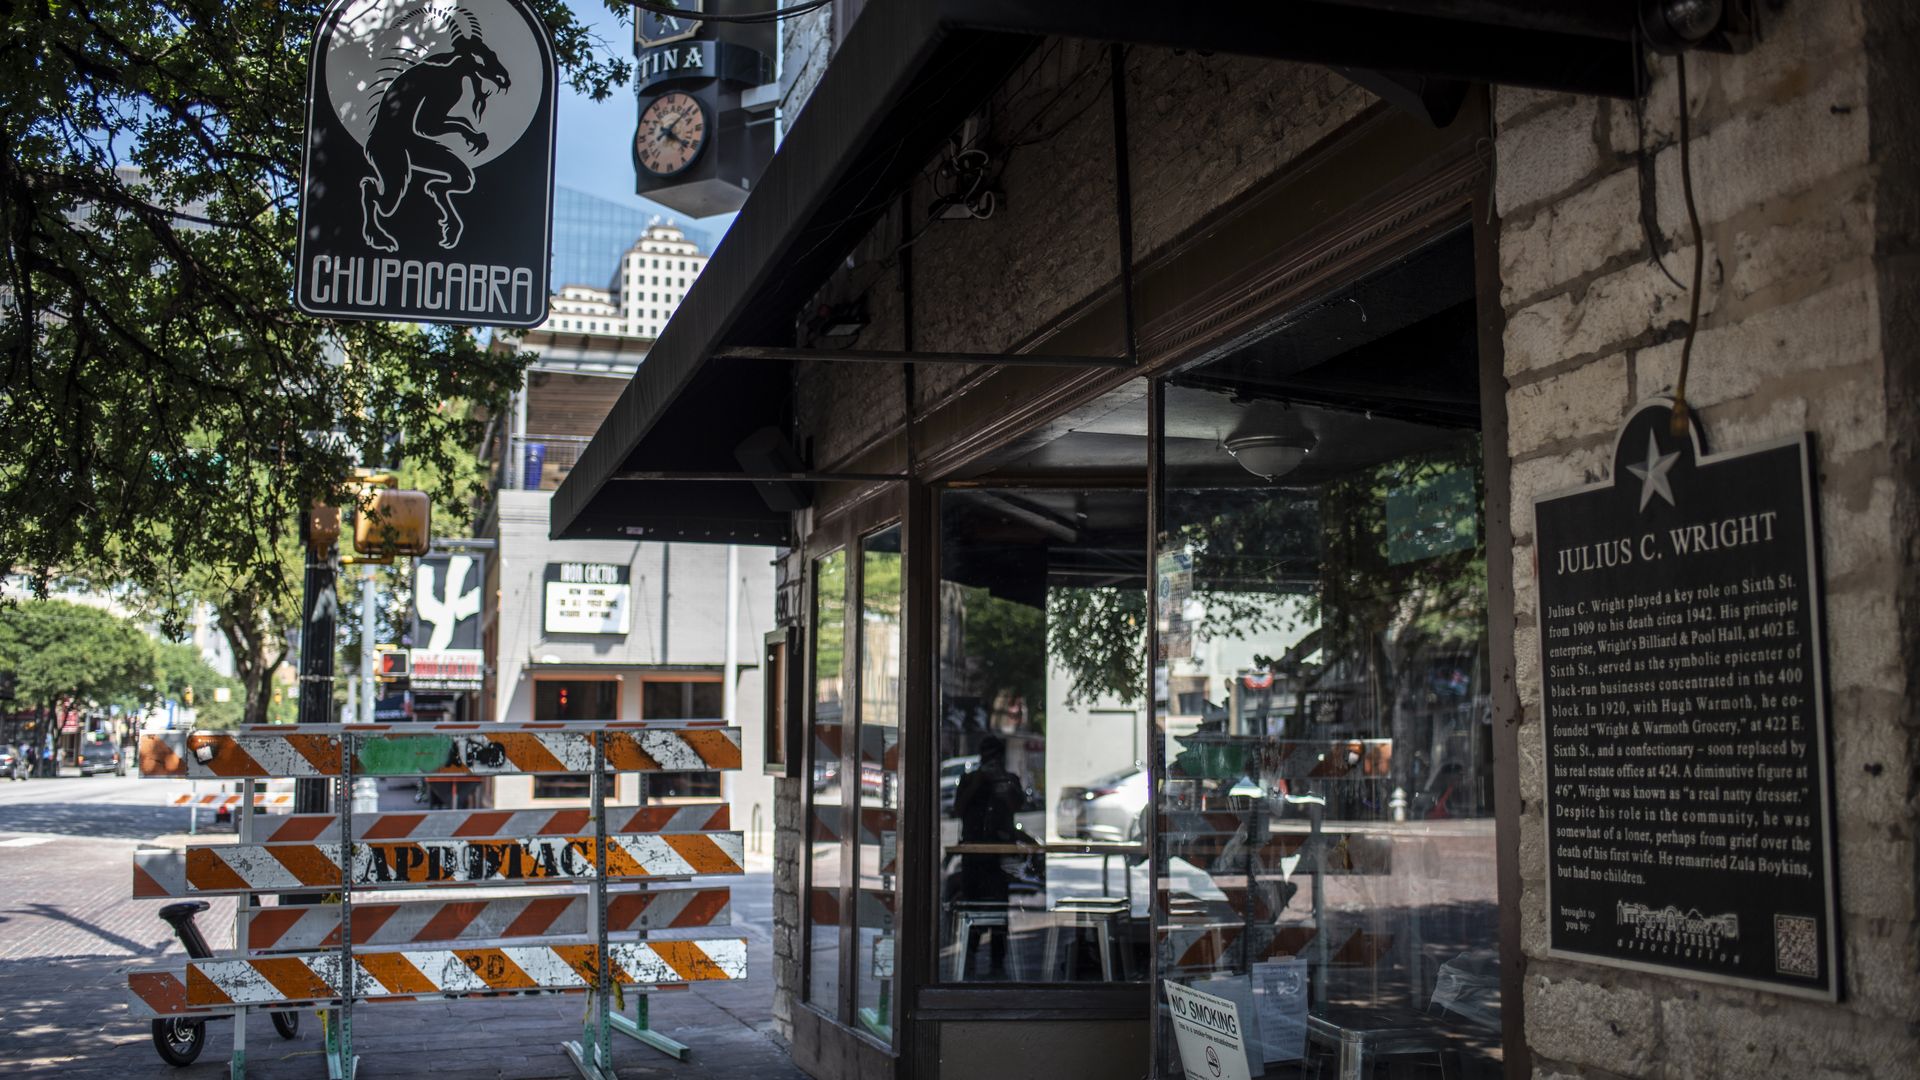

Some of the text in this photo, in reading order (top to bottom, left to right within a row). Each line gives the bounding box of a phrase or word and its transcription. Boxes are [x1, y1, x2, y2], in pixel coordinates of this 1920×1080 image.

[310, 254, 533, 315] CHUPACABRA
[1557, 511, 1776, 574] JULIUS C. WRIGHT
[1547, 573, 1795, 618] Julius C. Wright played a key role on Sixth St.
[1548, 596, 1798, 638] from 1909 to his death circa 1942. His principle
[1549, 620, 1798, 659] enterprise, Wright's Billiard & Pool Hall, at 402 E.
[1549, 642, 1802, 677] Sixth St., served as the symbolic epicenter of
[1550, 667, 1802, 697] black-run businesses concentrated in the 400
[1551, 692, 1803, 717] block. In 1920, with Hugh Warmoth, he co-
[1552, 722, 1589, 736] founded
[1630, 721, 1640, 735] &
[1642, 719, 1689, 734] Warmoth
[1750, 719, 1761, 731] at
[1764, 715, 1786, 731] 422
[1791, 715, 1803, 730] E.
[1553, 743, 1577, 757] Sixth
[1578, 743, 1595, 758] St.,
[1597, 743, 1614, 756] and
[1616, 746, 1622, 756] a
[1624, 741, 1694, 759] confectionary
[1707, 744, 1733, 755] soon
[1736, 739, 1787, 758] replaced
[1790, 739, 1805, 757] by
[1554, 763, 1807, 781] his real estate office at 424. A diminutive figure at
[1578, 784, 1610, 801] Wright
[1611, 787, 1631, 798] was
[1632, 784, 1666, 799] known
[1668, 789, 1680, 800] as
[1698, 786, 1719, 800] real
[1722, 789, 1751, 804] natty
[1555, 803, 1809, 828] Despite his role in the community, he was
[1556, 825, 1810, 851] somewhat of a loner, perhaps from grief over the
[1556, 843, 1812, 878] death of his first wife. He remarried Zula Boykins,
[1557, 863, 1645, 884] but had no children.
[1560, 904, 1595, 920] brought to
[1565, 920, 1578, 931] you
[1635, 926, 1719, 950] PECAN STREET
[441, 953, 505, 986] APD
[1171, 994, 1186, 1015] NO
[1188, 1000, 1238, 1035] SMOKING
